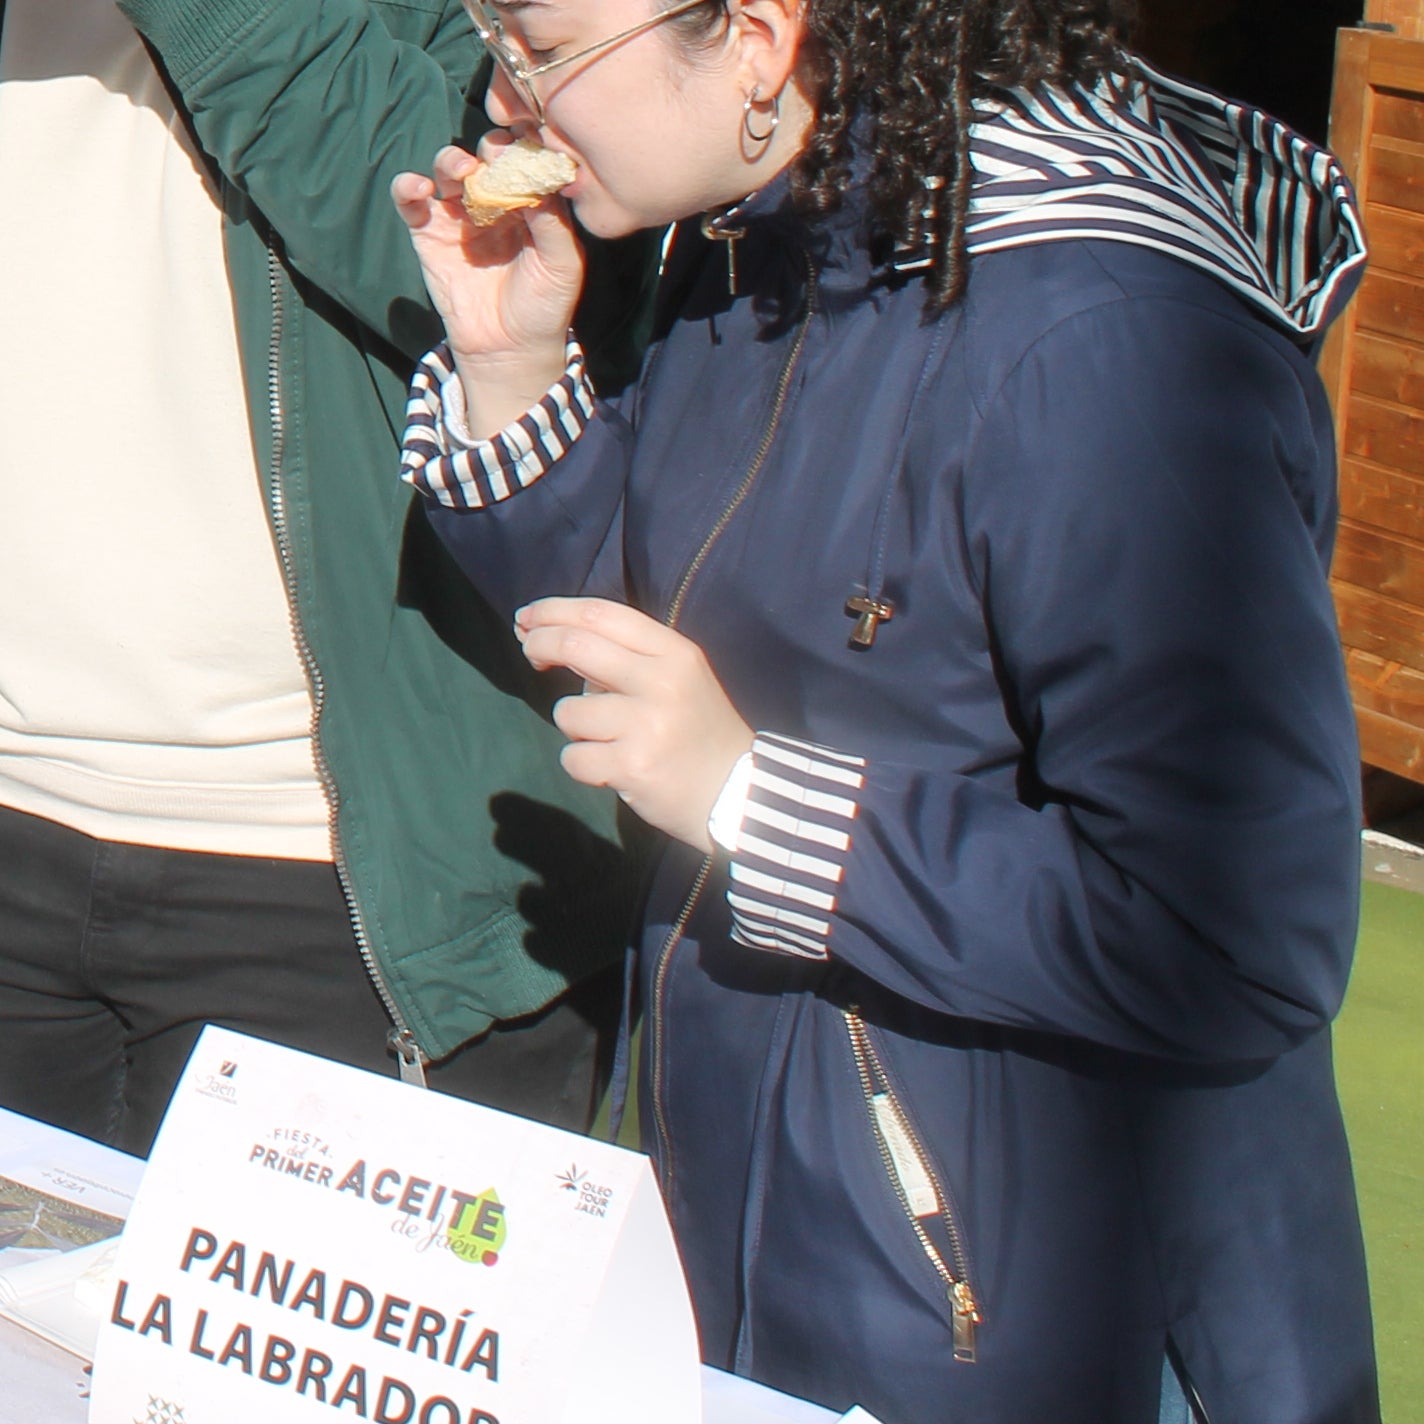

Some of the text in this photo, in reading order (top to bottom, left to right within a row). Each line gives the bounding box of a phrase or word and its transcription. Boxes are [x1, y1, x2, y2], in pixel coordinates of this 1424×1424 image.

[272, 1127, 330, 1156] FIESTA
[248, 1143, 506, 1244] PRIMER ACEITE
[579, 1190, 610, 1209] TOUR
[582, 1182, 613, 1199] OLEO
[390, 1212, 479, 1260] de Jaén
[109, 1279, 174, 1346] LA
[178, 1226, 502, 1384] PANADERÍA
